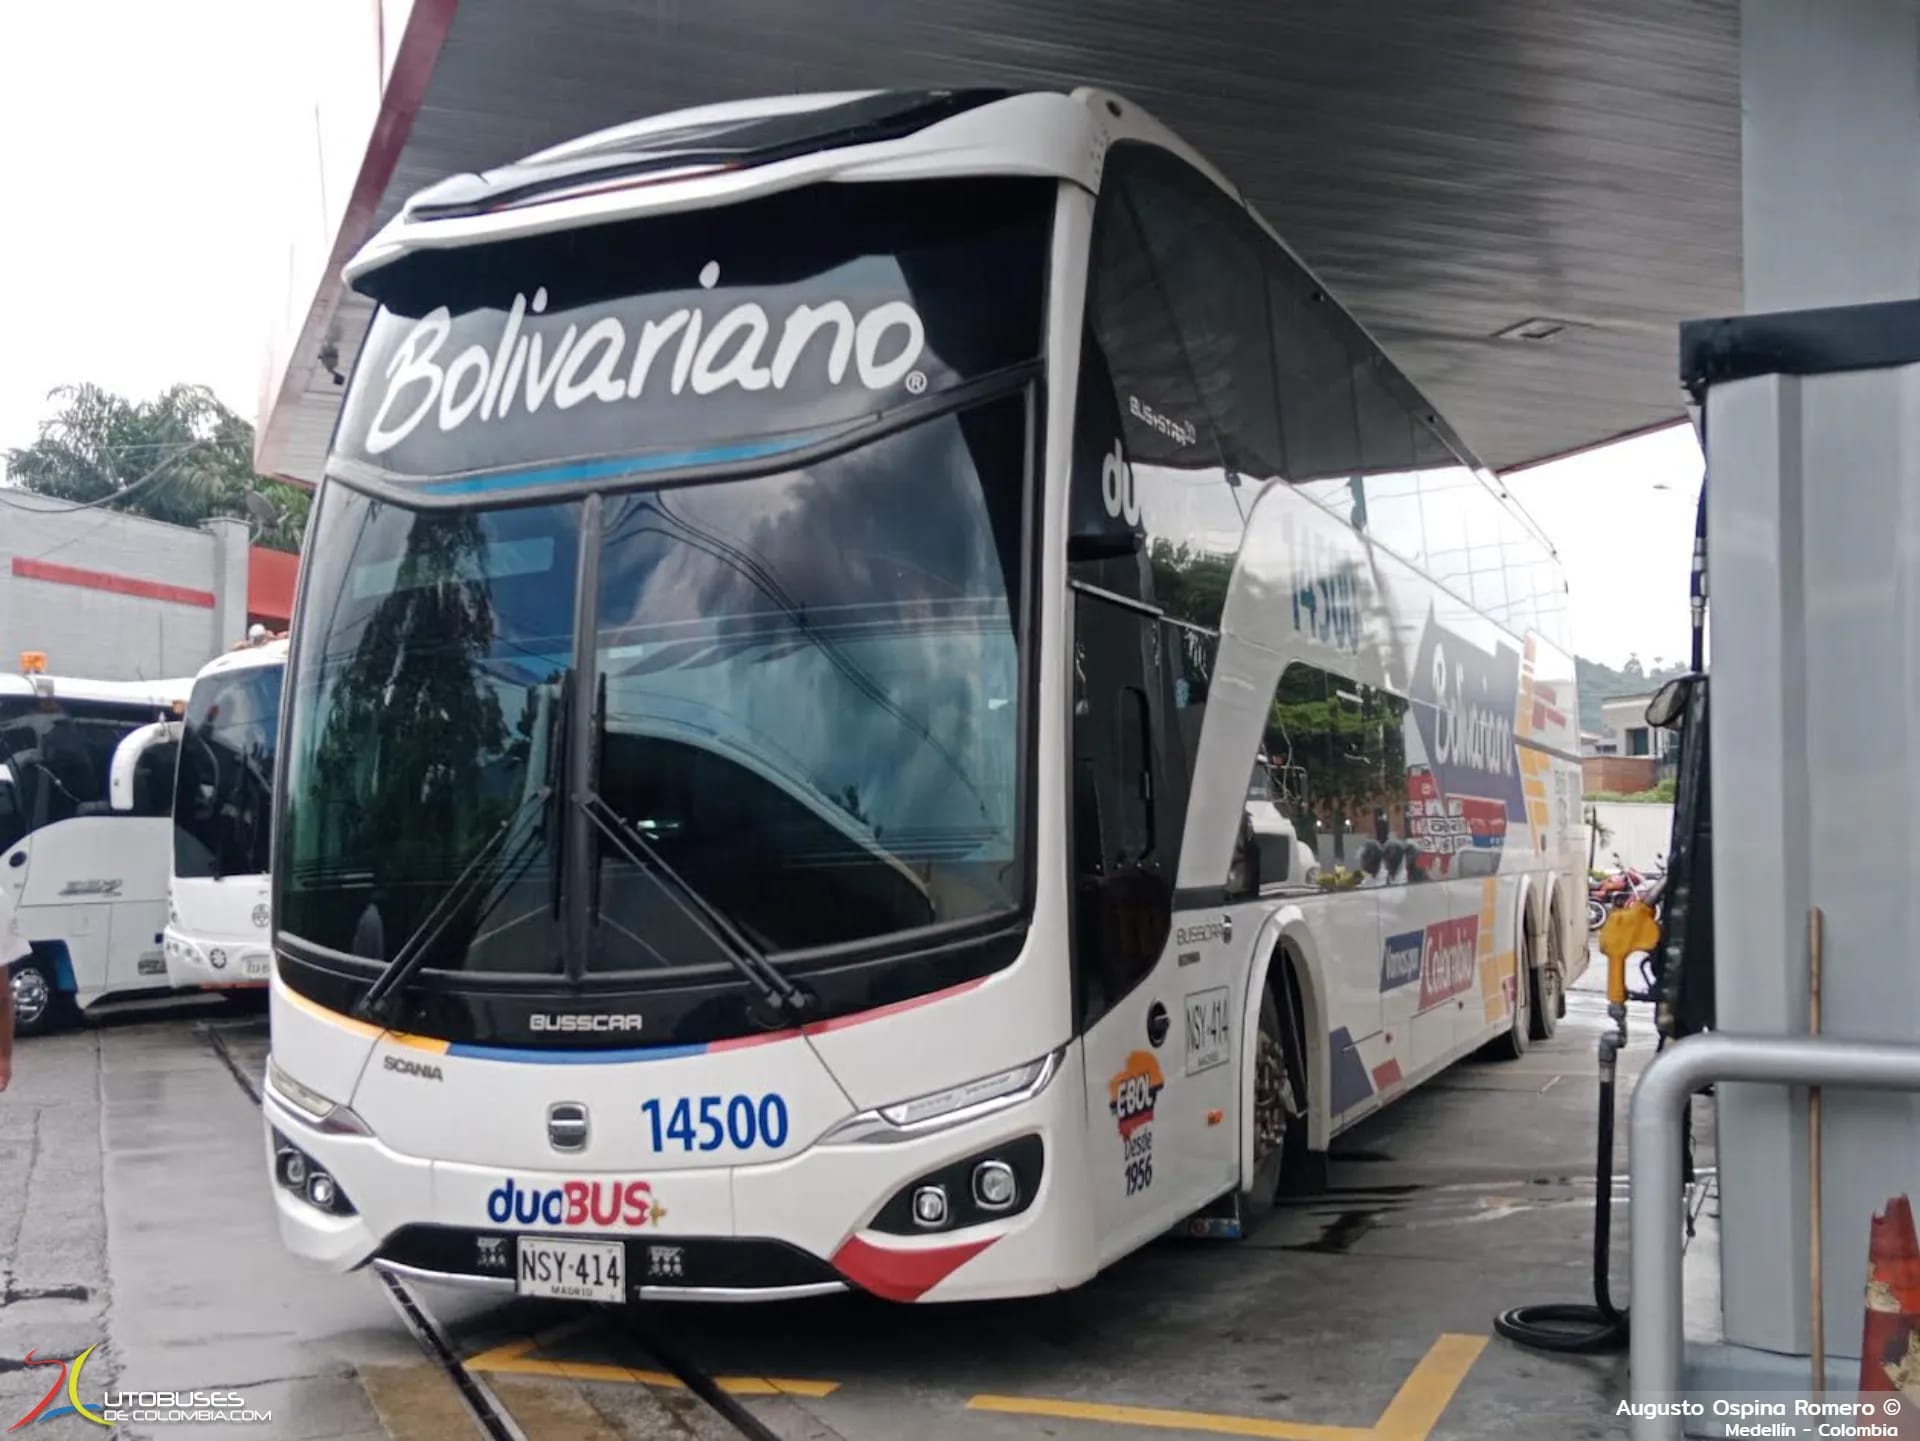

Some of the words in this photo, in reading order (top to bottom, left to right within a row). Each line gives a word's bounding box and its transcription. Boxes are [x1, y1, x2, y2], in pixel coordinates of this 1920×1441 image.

[530, 1014, 642, 1031] BUSSCAR
[384, 1055, 444, 1082] SCANIA
[641, 1093, 789, 1152] 14500
[1125, 1154, 1153, 1196] 1956
[551, 1284, 593, 1297] MADRID
